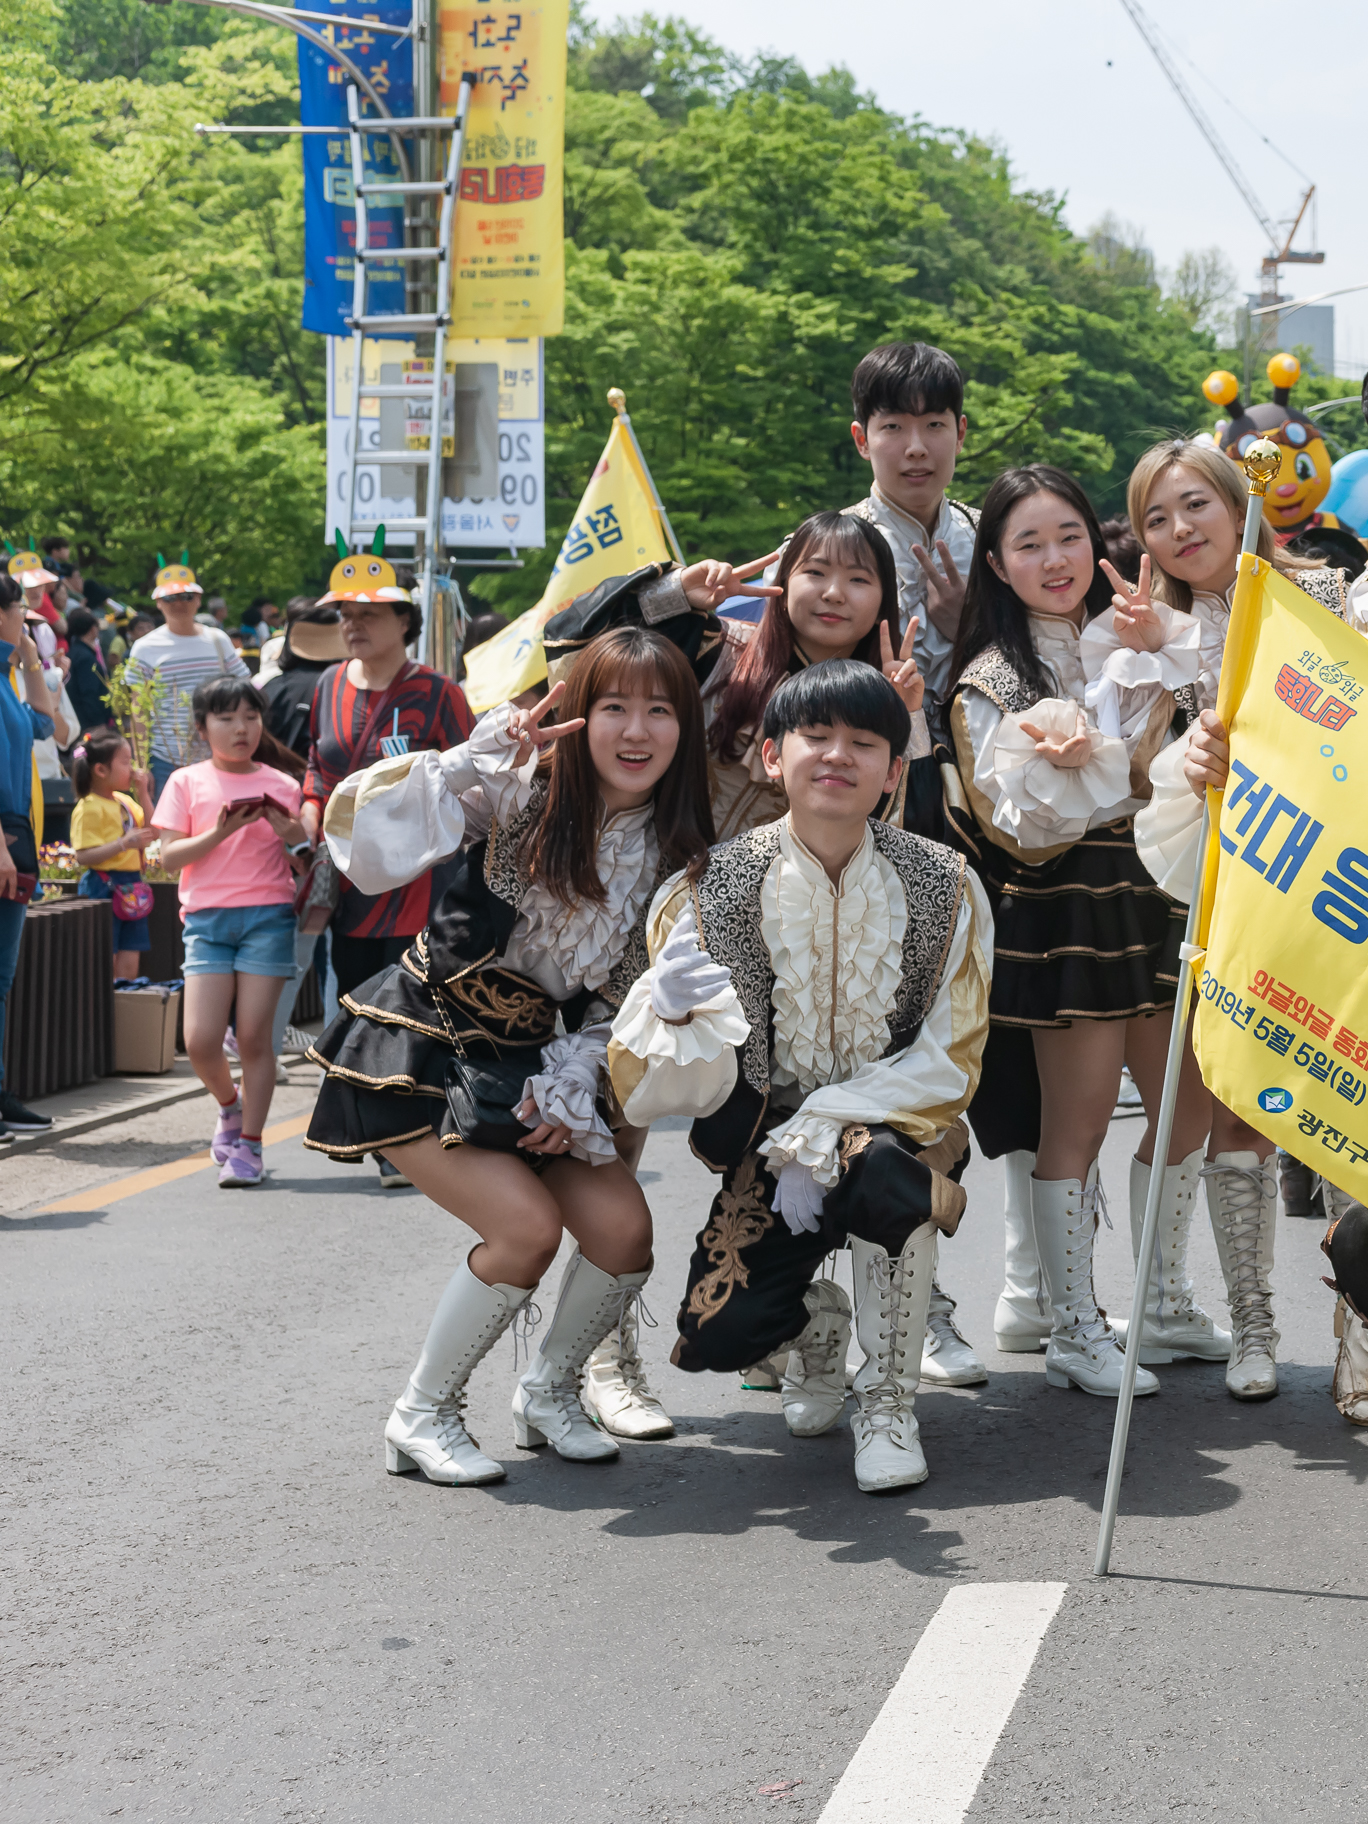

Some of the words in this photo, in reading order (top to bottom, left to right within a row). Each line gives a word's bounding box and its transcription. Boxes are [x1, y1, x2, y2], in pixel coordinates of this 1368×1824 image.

[1274, 663, 1357, 731] 동화나라
[1297, 650, 1323, 673] 와글
[1338, 680, 1364, 702] 와글
[1218, 758, 1325, 895] 건대
[1200, 970, 1257, 1031] 2019년
[1253, 1016, 1296, 1057] 5월
[1293, 1042, 1367, 1106] 5일(일)
[1247, 969, 1336, 1041] 와글와글
